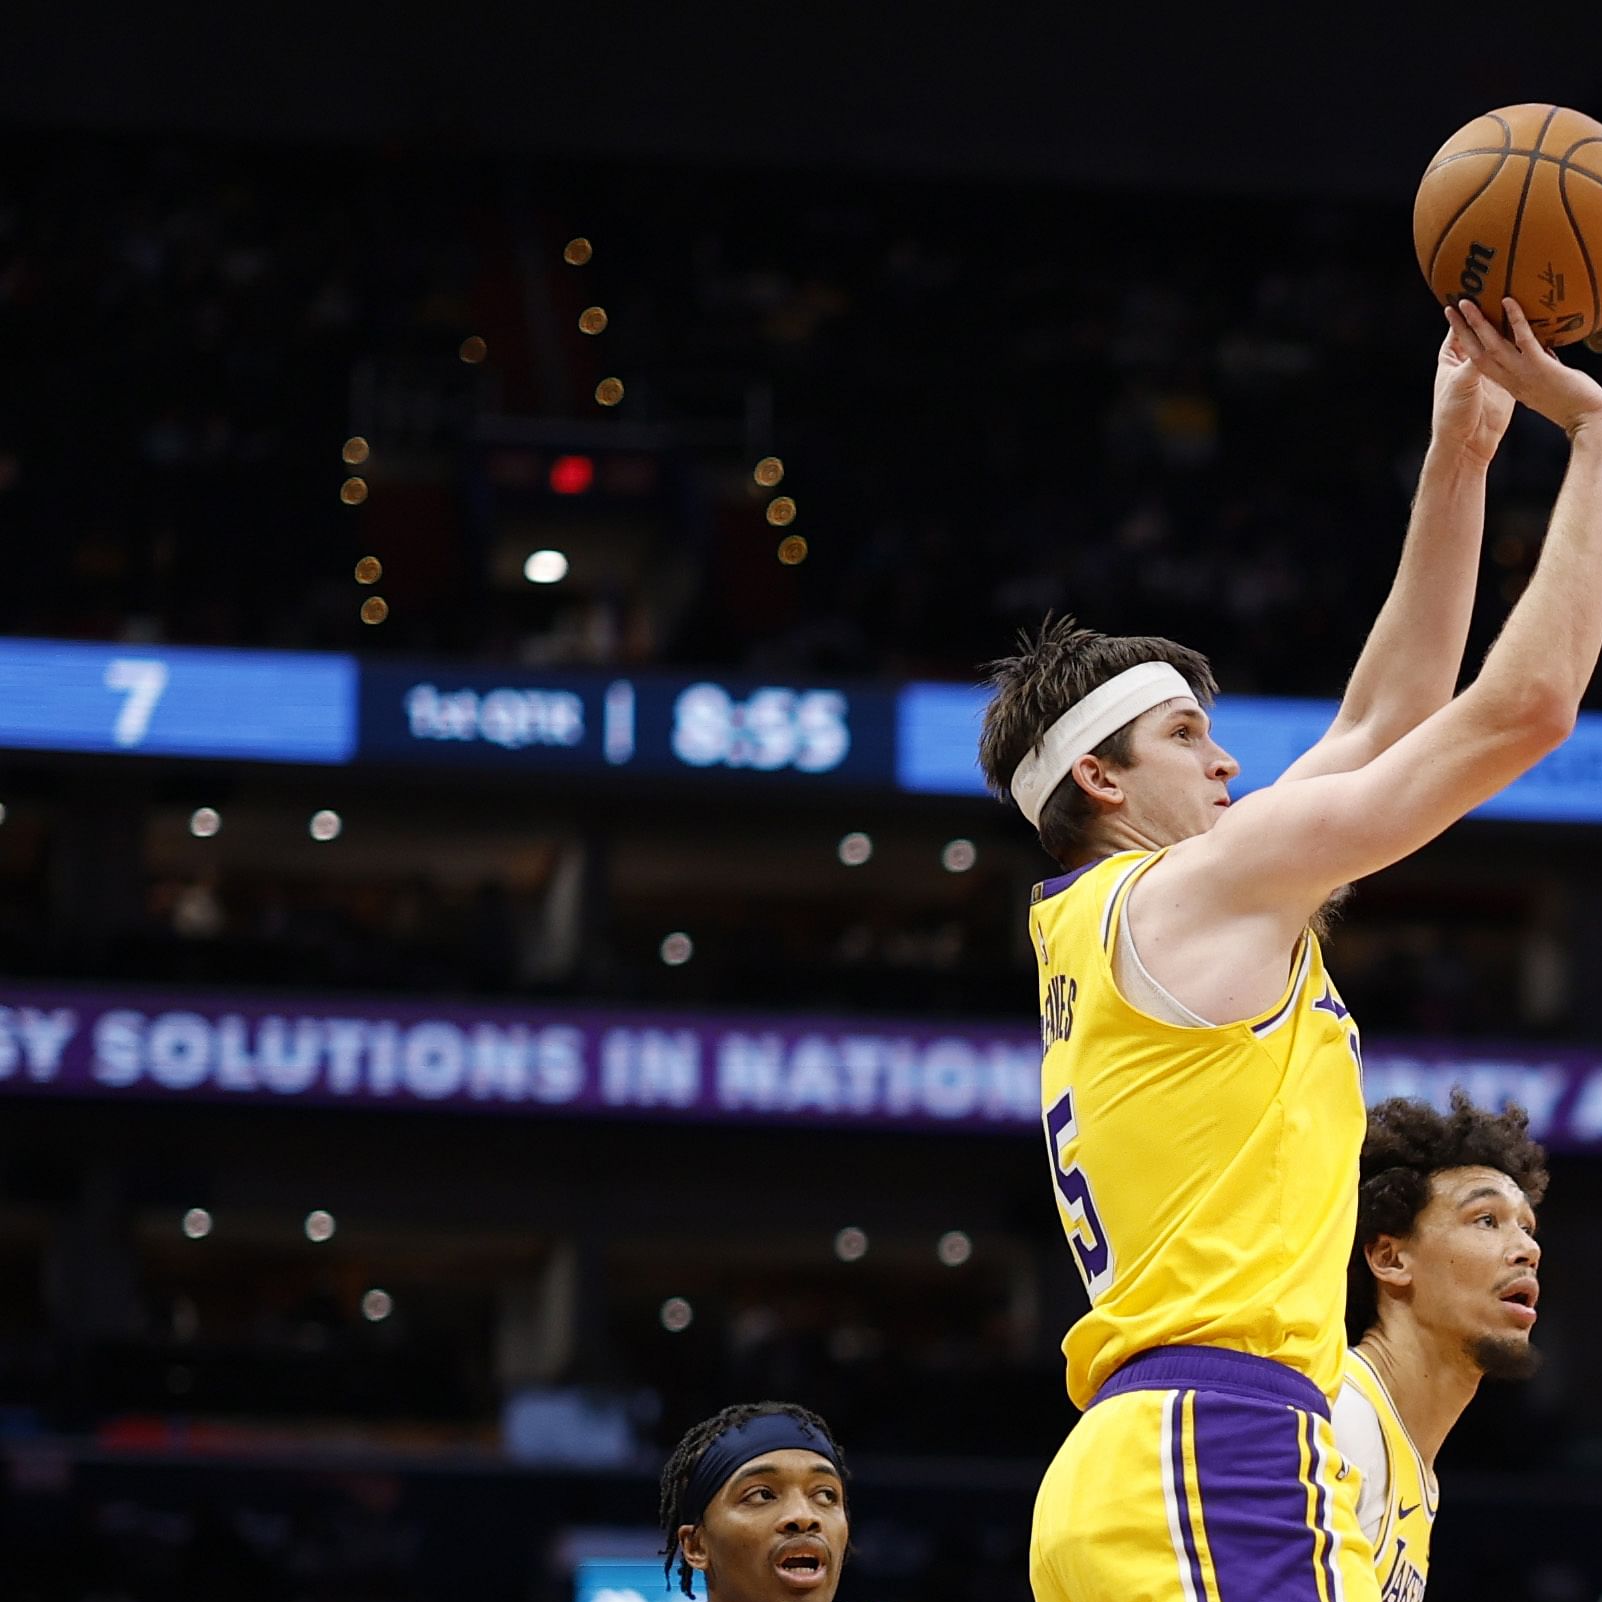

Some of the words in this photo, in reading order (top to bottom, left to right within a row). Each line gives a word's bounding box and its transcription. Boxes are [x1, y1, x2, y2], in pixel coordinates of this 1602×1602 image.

[103, 657, 170, 749] 7
[93, 1008, 586, 1105] SOLUTIONS
[601, 1026, 700, 1110] IN
